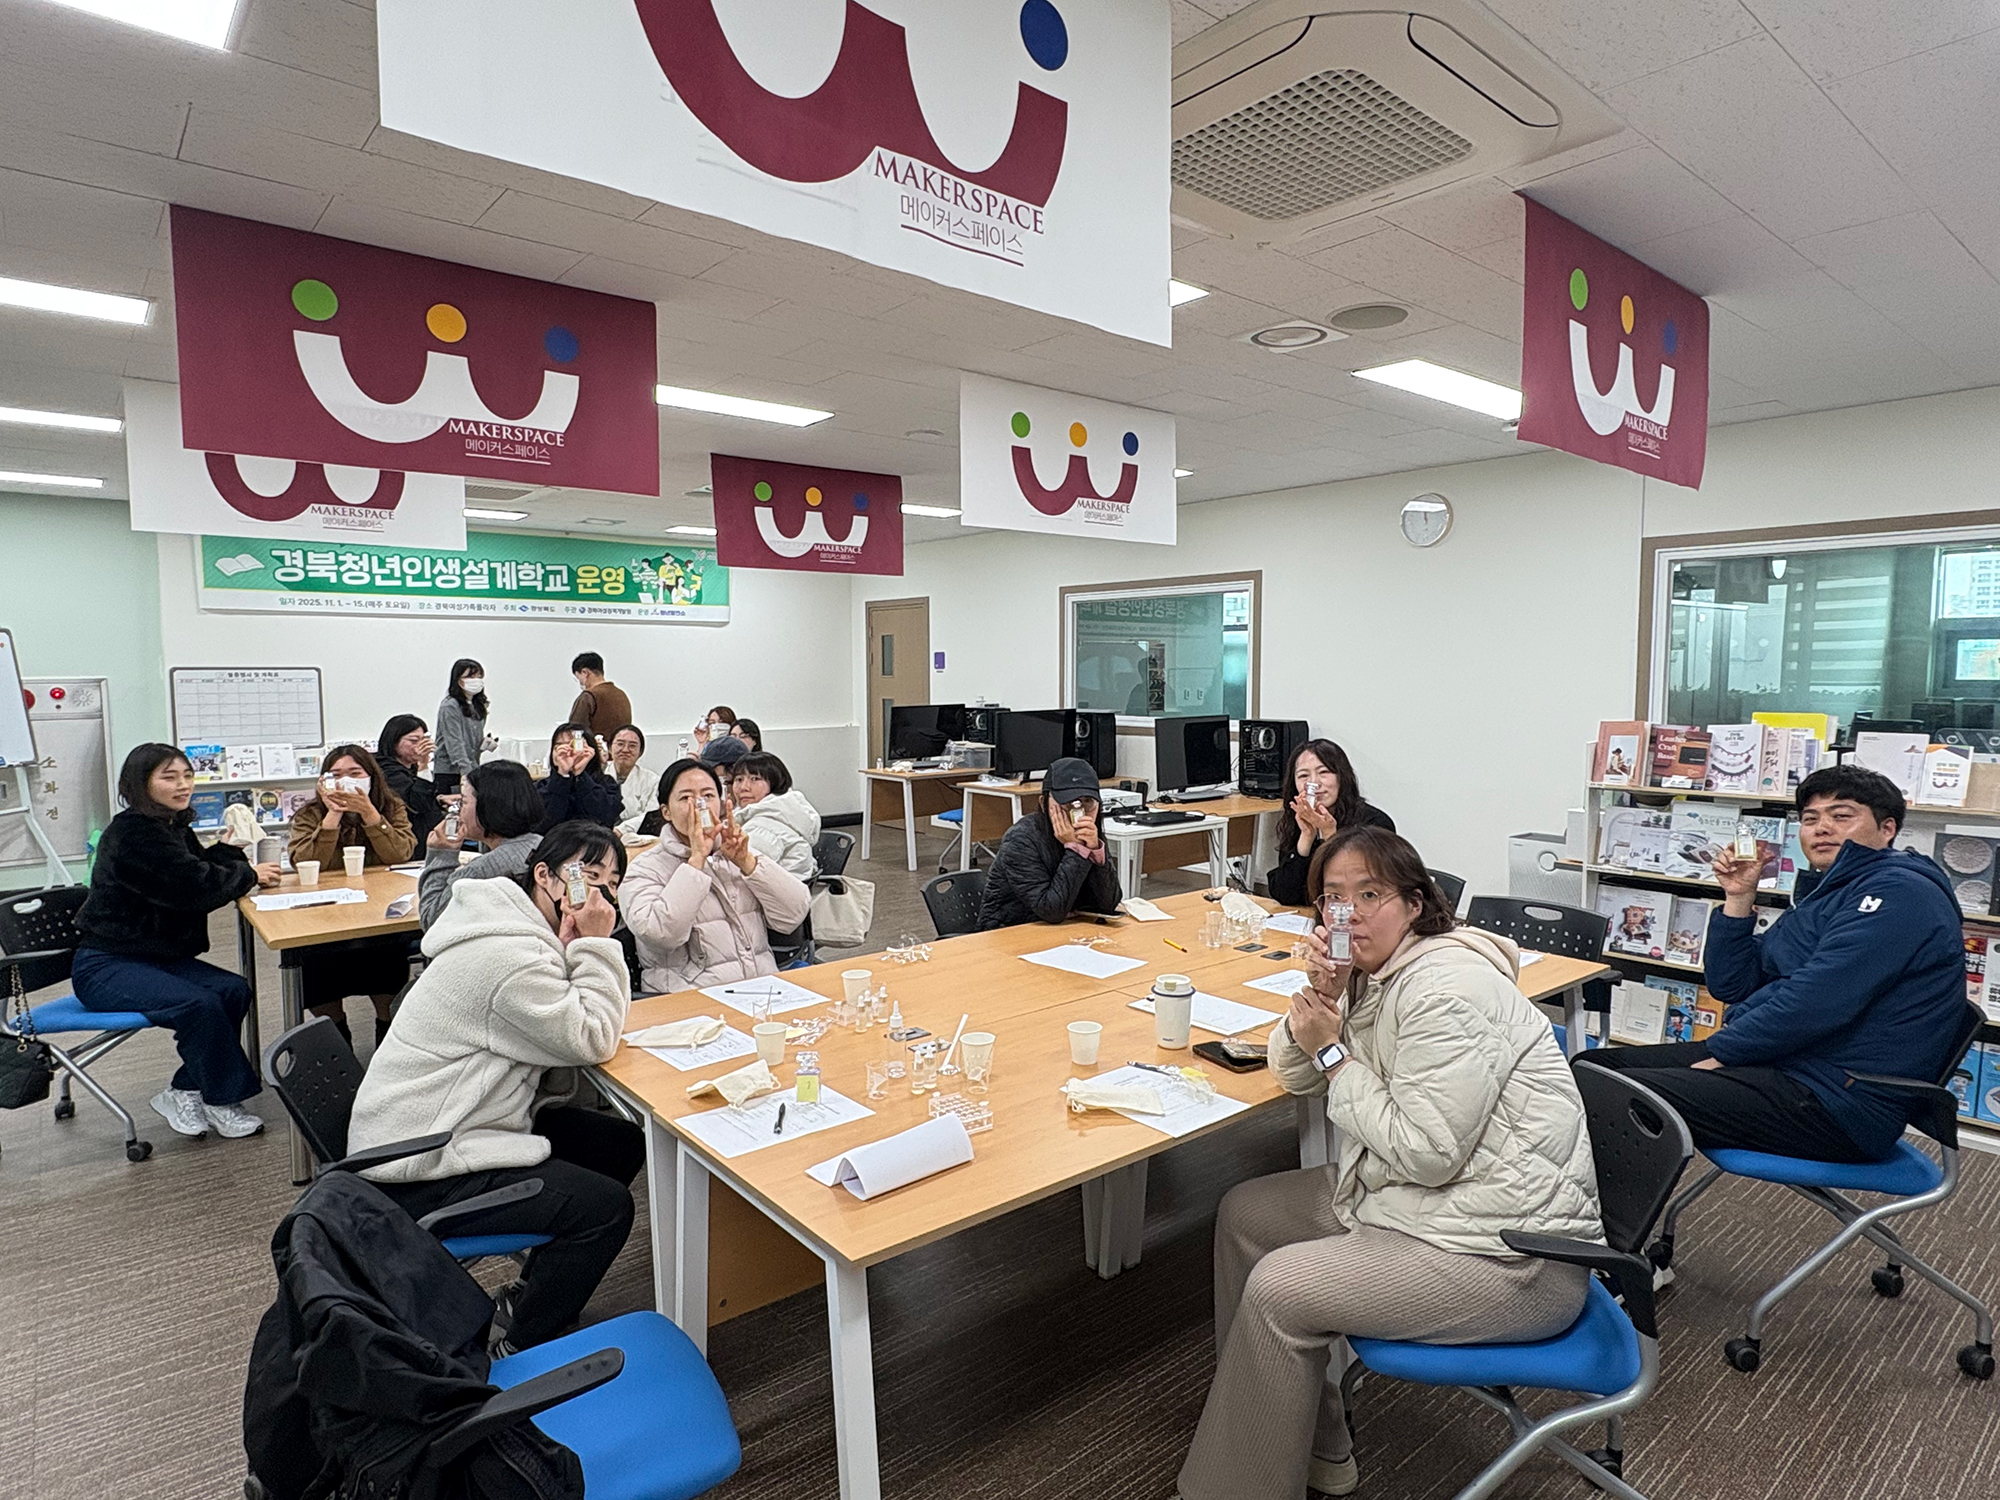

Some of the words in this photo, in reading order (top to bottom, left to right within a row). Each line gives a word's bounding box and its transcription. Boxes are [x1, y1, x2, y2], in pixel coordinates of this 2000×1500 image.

[874, 151, 1044, 235] MAKERSPACE
[901, 195, 1023, 255] 메이커스페이스
[448, 420, 565, 447] MAKERSPACE
[1625, 413, 1668, 441] MAKERSPACE
[465, 439, 551, 459] 메이커스페이스
[310, 506, 395, 520] MAKERSPACE
[1077, 500, 1130, 513] MAKERSPACE
[813, 545, 862, 554] MAKERSPACE
[271, 549, 571, 593] 경북청년인생설계학교
[576, 565, 626, 596] 운영
[279, 597, 296, 606] 일자
[298, 598, 322, 606] 2025.
[325, 599, 335, 607] 11.
[435, 602, 496, 611] 경북여성가족플라자
[1758, 826, 1778, 840] 24
